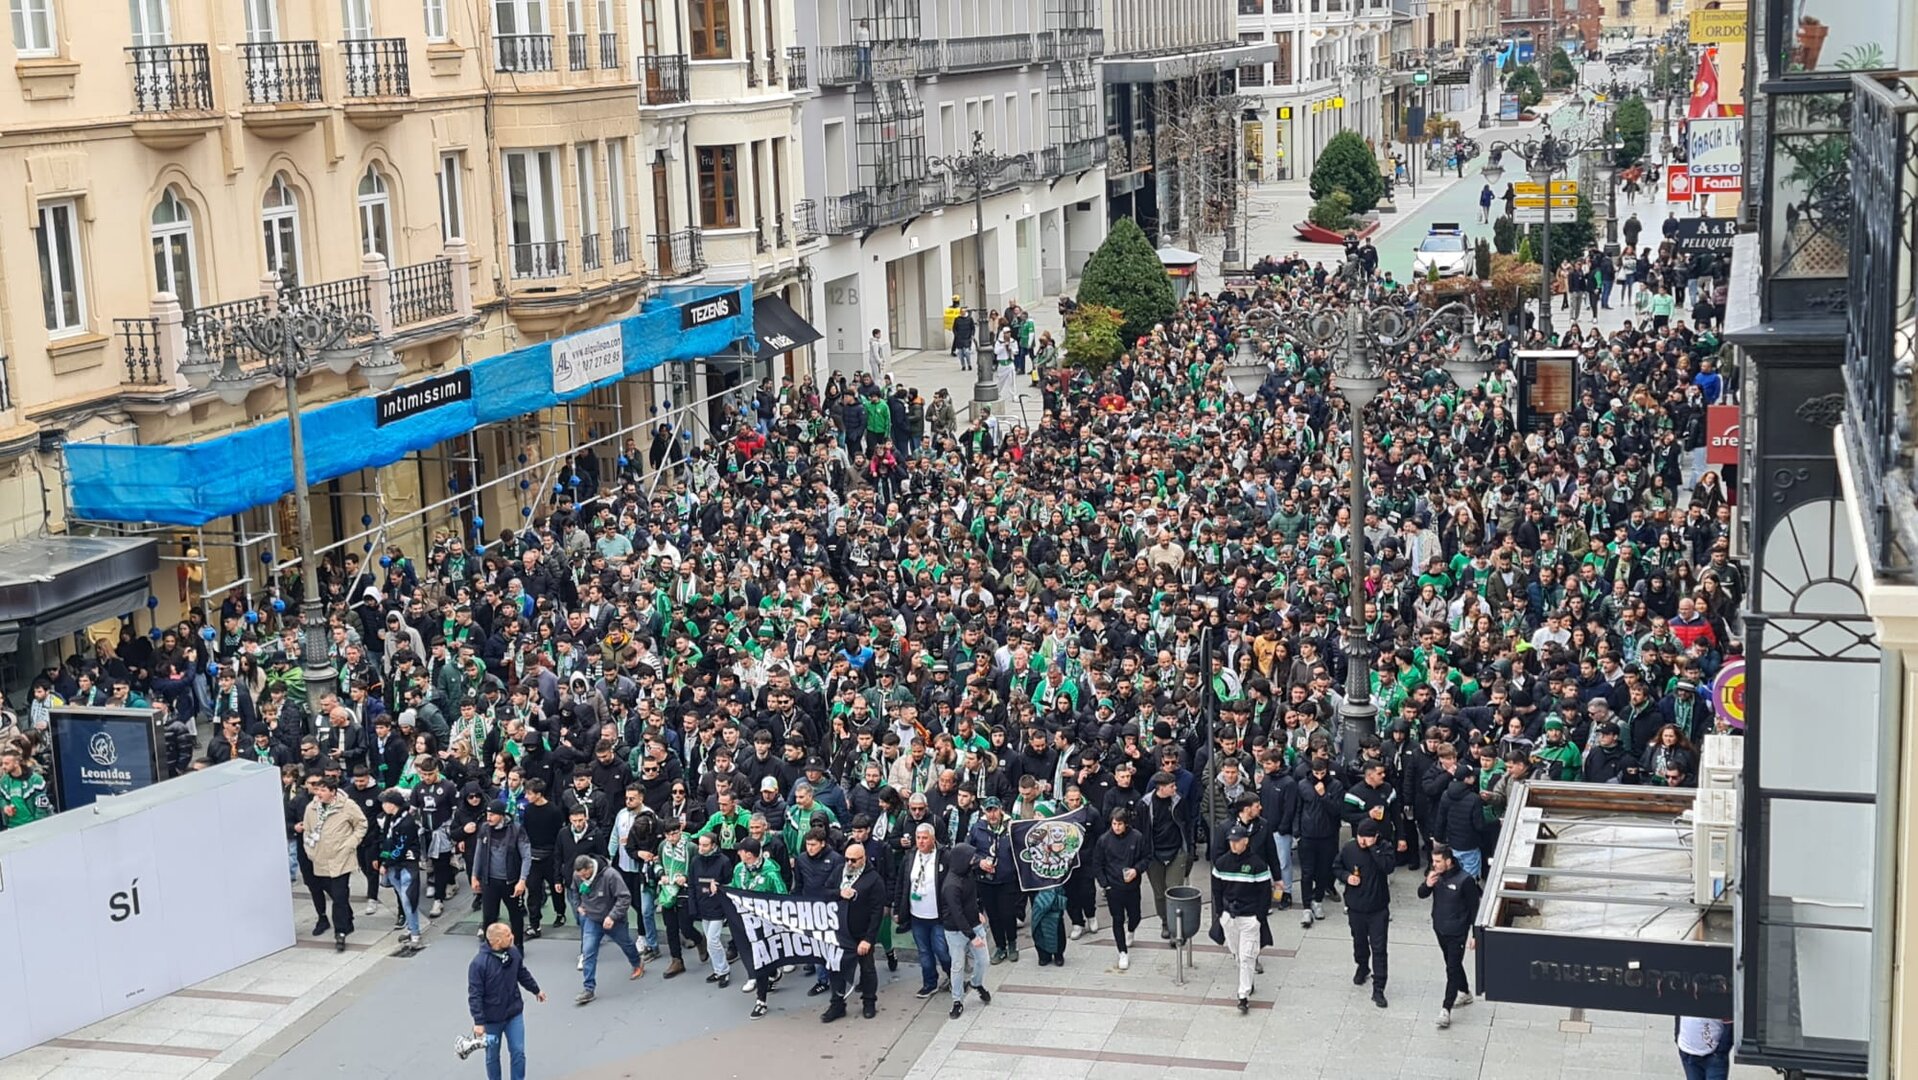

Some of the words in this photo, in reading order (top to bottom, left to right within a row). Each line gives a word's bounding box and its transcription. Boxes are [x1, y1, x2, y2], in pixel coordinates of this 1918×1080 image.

[1691, 164, 1741, 174] GESTO
[1696, 221, 1709, 234] A
[1712, 225, 1720, 234] &
[1725, 221, 1736, 234] R
[828, 287, 844, 305] 12
[848, 287, 859, 305] B
[690, 297, 729, 324] TEZENIS
[81, 766, 132, 780] Leonidas
